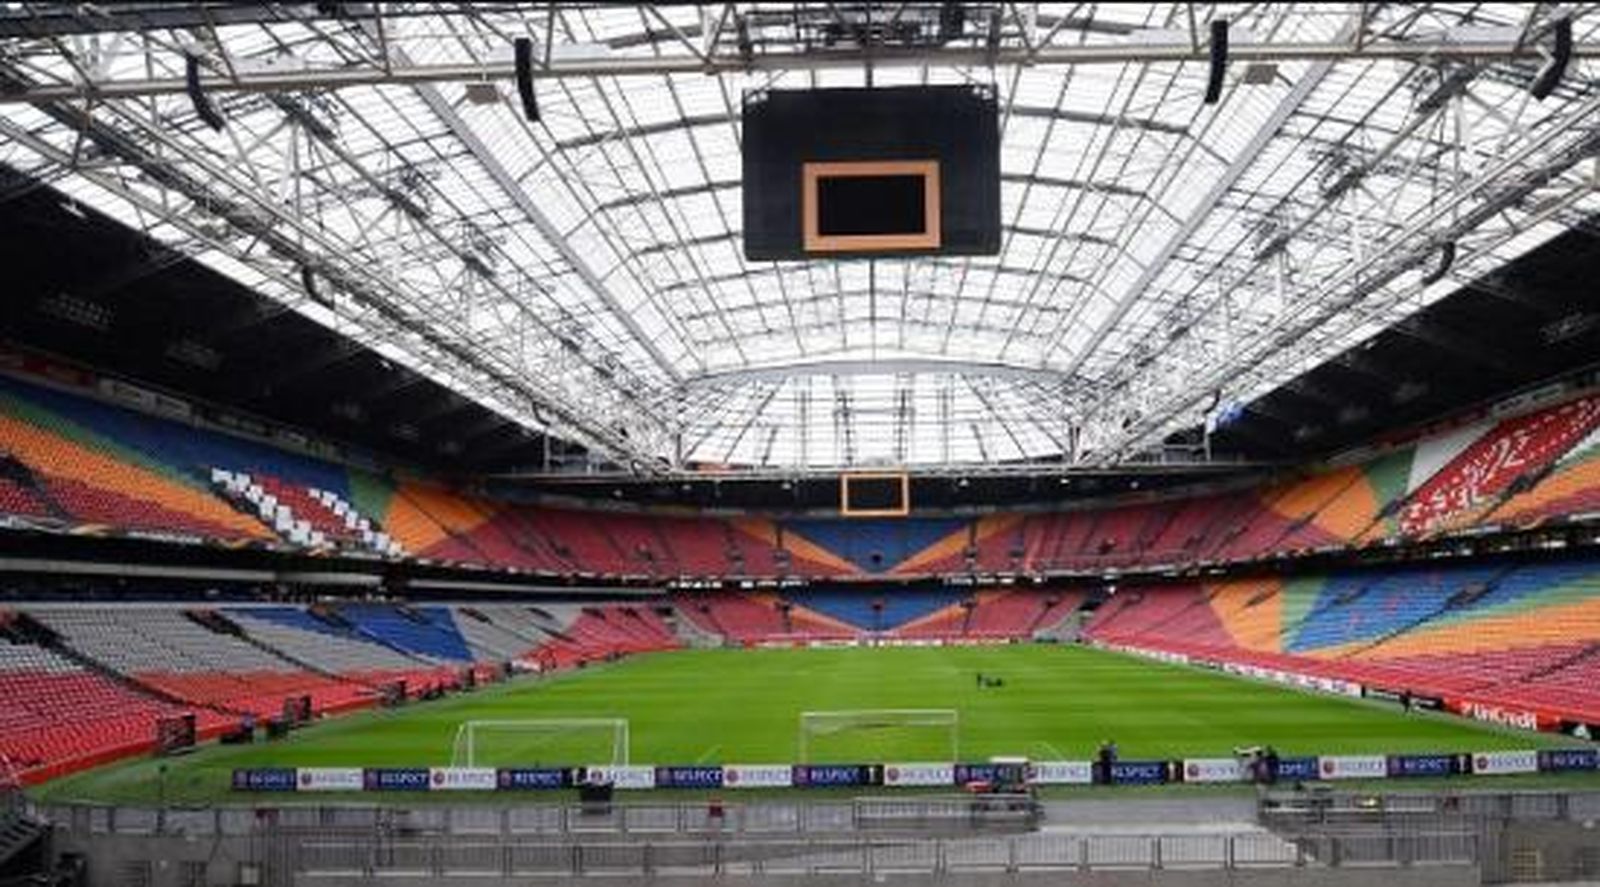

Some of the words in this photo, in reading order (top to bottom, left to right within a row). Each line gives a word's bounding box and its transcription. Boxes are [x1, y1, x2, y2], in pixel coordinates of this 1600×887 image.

[1474, 702, 1537, 730] UniCredit
[811, 768, 859, 780] RESPECT
[1279, 762, 1317, 774] ESPECT
[381, 771, 427, 783] RESPECT
[514, 771, 561, 783] RESPECT
[673, 769, 722, 781] RESPECT
